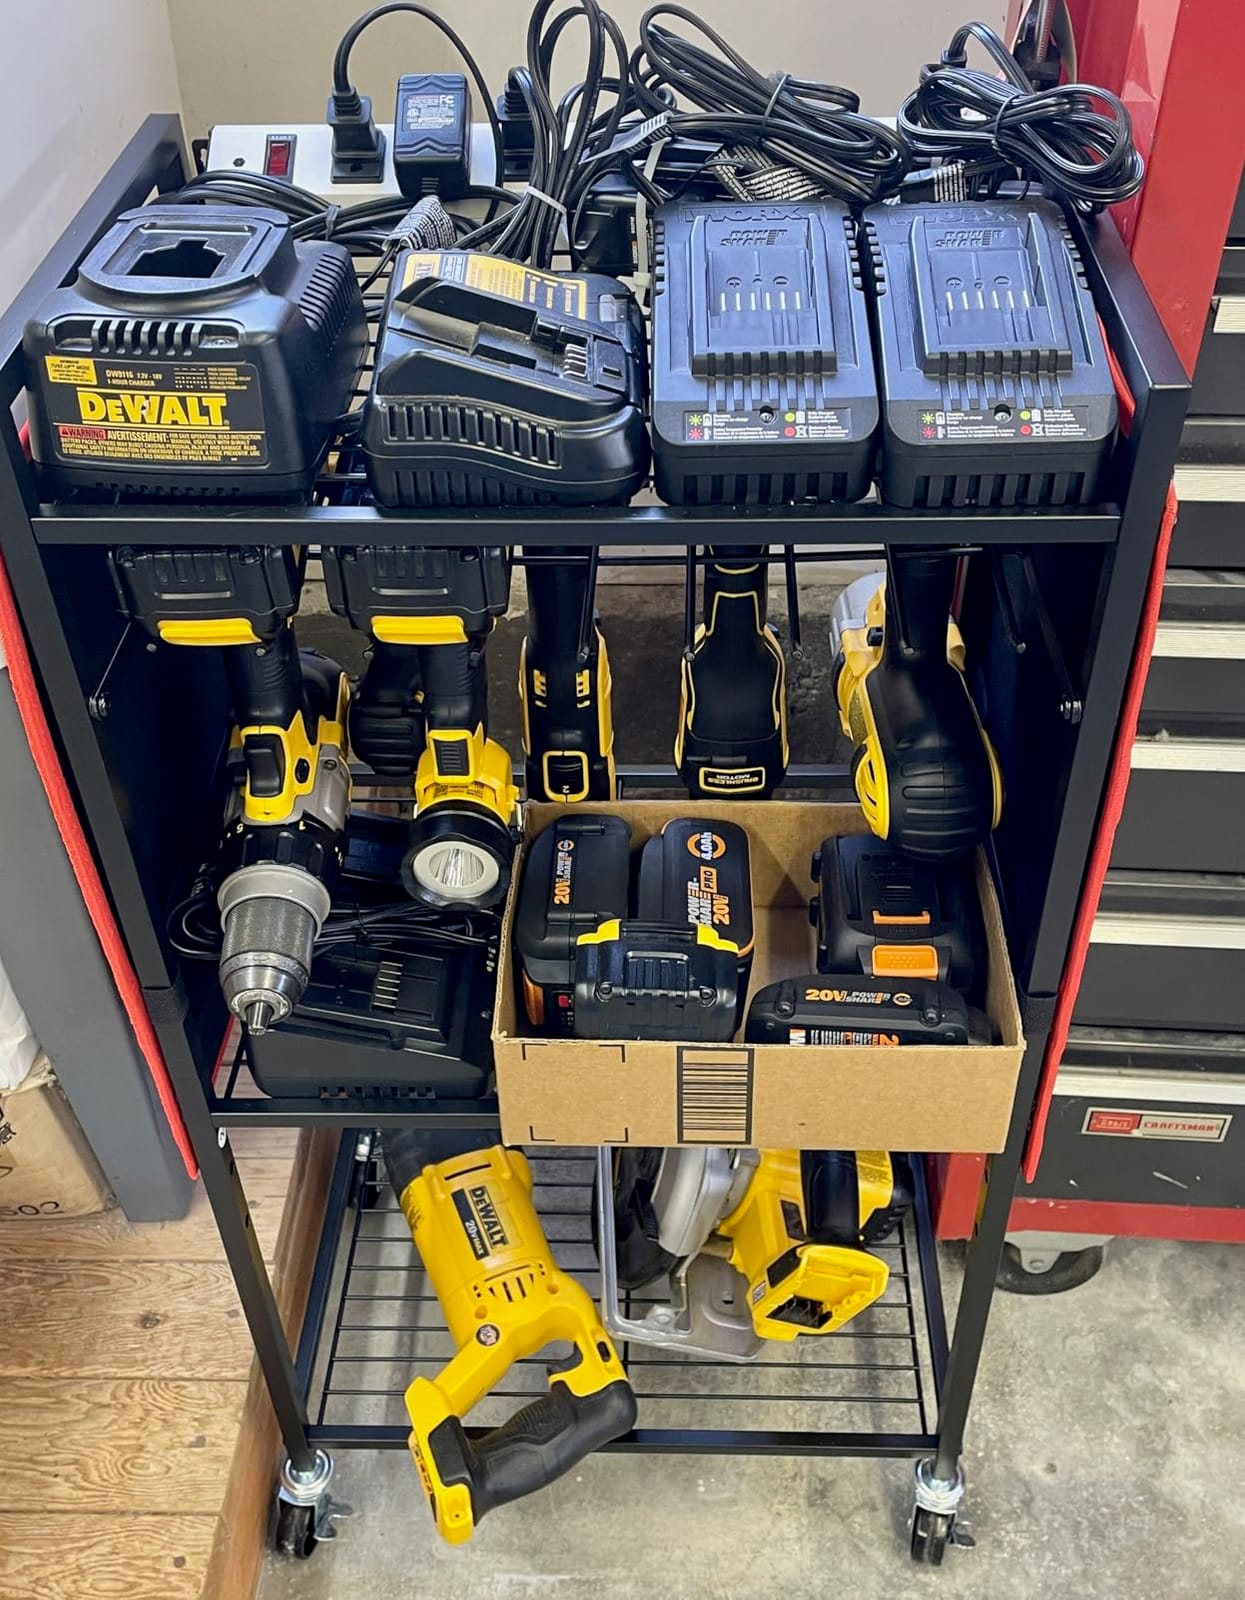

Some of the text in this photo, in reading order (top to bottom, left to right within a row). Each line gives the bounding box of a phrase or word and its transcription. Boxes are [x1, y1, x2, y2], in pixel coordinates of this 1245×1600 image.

[69, 427, 105, 439] WARNING
[707, 776, 759, 785] BRUSHLESS
[703, 869, 714, 890] PRO
[804, 988, 848, 1003] 20V
[1143, 1120, 1215, 1132] CRAFTSMAN
